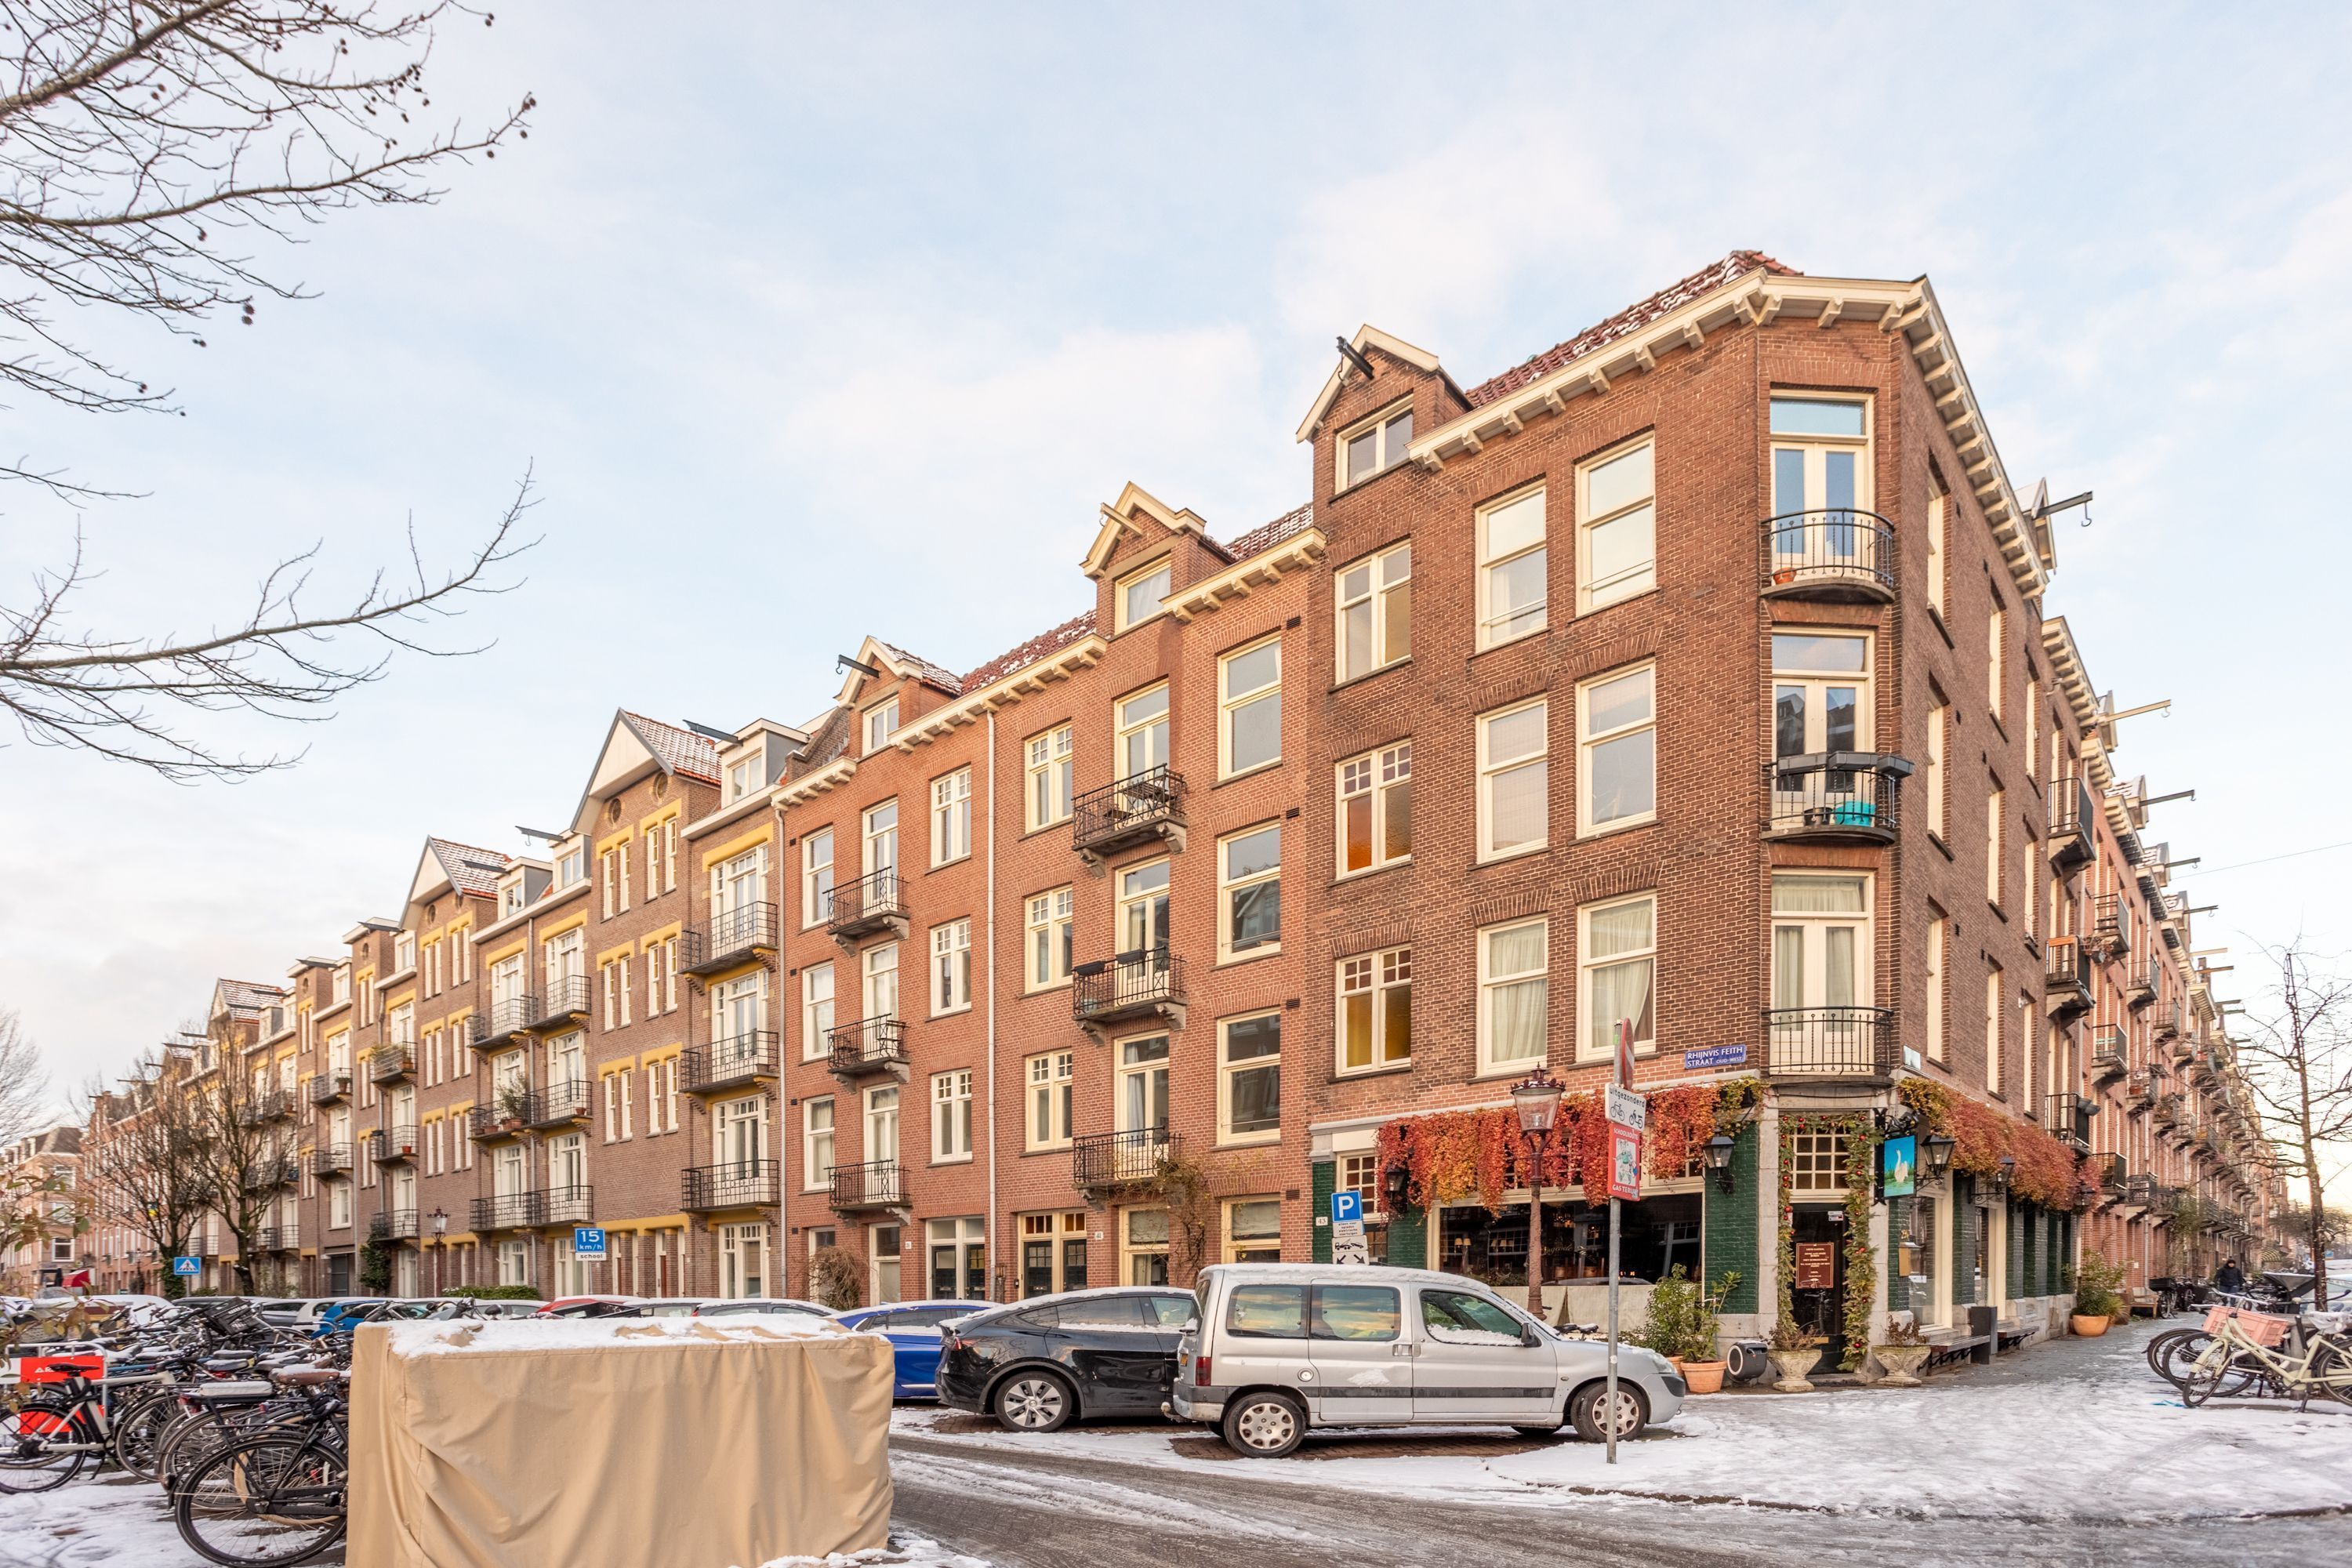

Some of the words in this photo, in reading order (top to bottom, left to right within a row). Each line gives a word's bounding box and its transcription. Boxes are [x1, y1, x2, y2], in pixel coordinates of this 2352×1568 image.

[1687, 1049, 1719, 1060] RHIJNVIS
[1721, 1047, 1743, 1055] FEITH
[1687, 1058, 1714, 1067] STRAAT
[1609, 1087, 1646, 1108] uitgezonderd
[1338, 1196, 1354, 1218] P
[580, 1231, 600, 1242] 15
